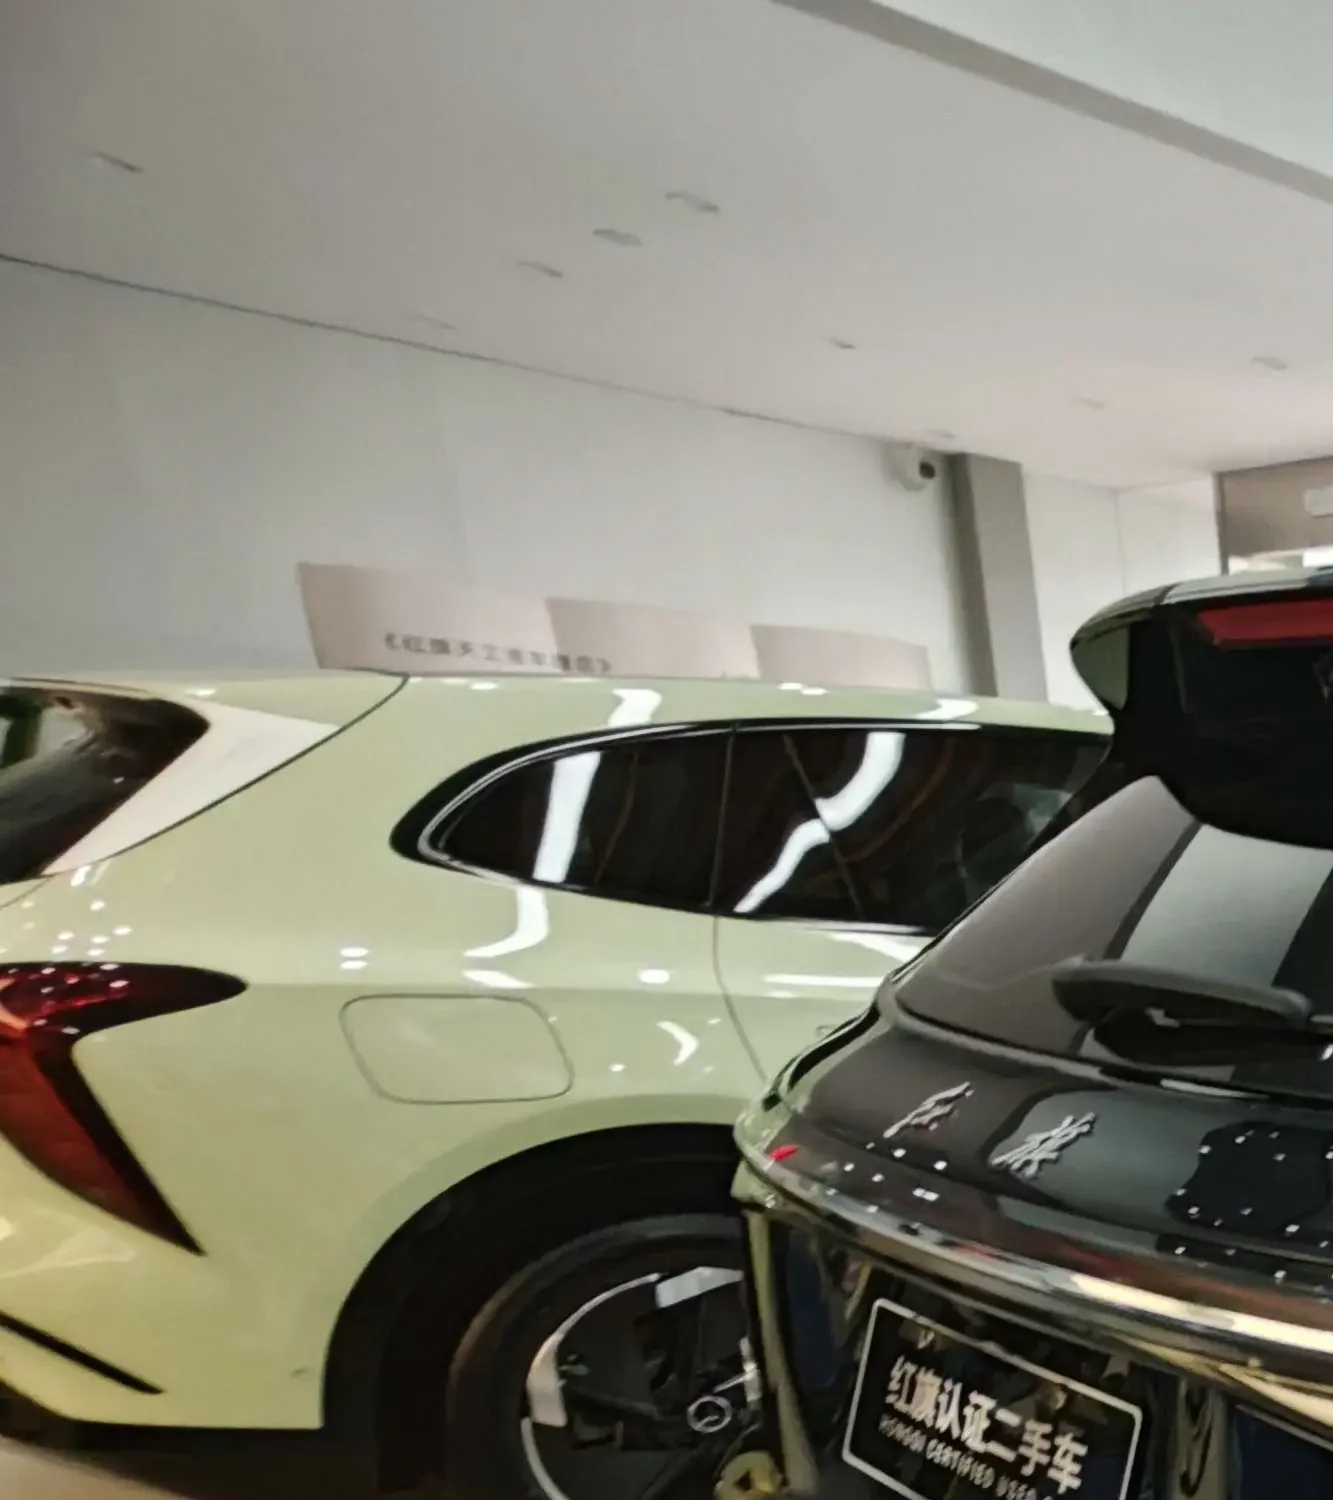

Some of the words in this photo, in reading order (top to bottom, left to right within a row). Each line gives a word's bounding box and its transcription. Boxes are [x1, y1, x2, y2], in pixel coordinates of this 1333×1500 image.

[885, 1355, 1089, 1495] 红旗认证二手车
[925, 1438, 995, 1489] CERTIFIED
